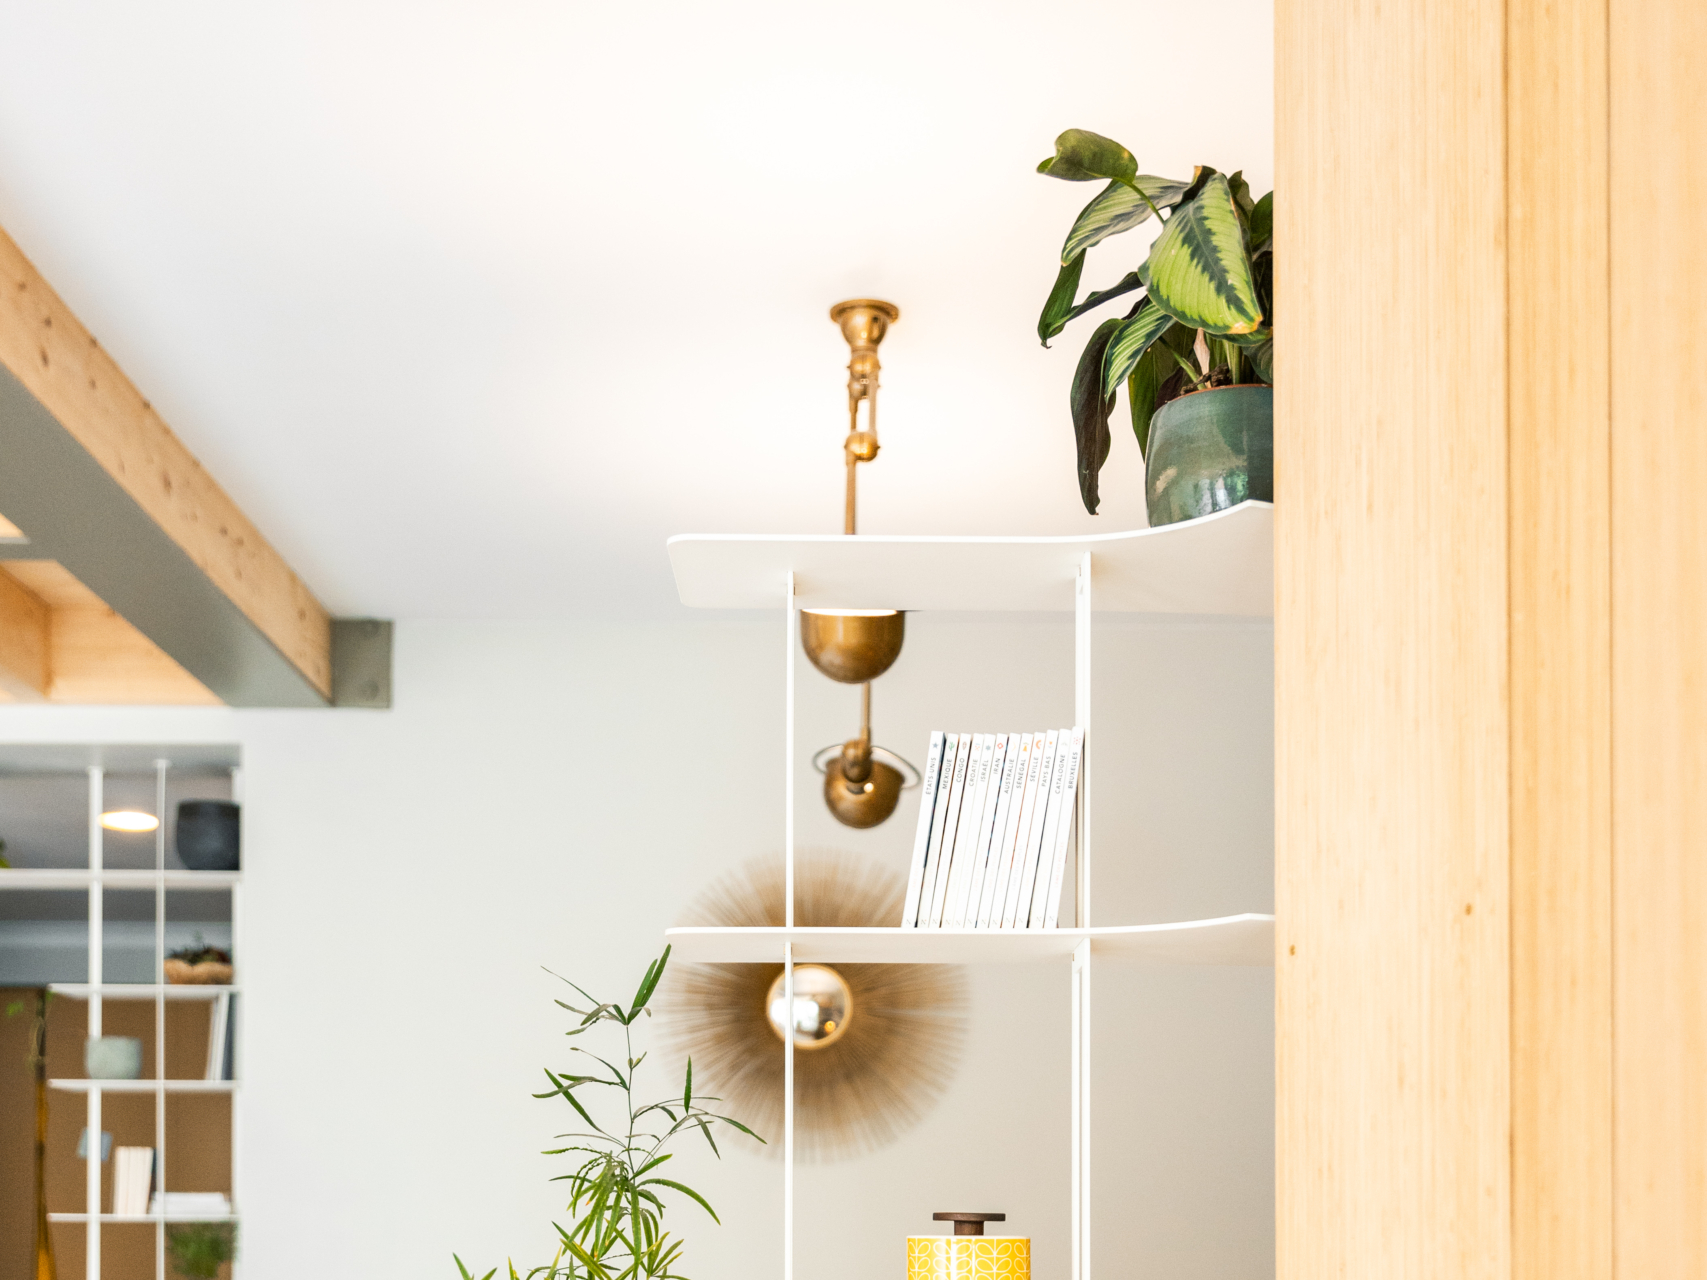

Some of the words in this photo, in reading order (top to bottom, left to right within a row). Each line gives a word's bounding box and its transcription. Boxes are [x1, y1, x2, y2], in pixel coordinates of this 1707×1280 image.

[942, 758, 952, 790] MEXIQUE
[956, 758, 965, 782] CONGO
[969, 758, 978, 786] CROATIE
[980, 760, 988, 782] ISRAËL
[1004, 758, 1014, 794] AUSTRALIE
[1030, 757, 1039, 782] SÉVILLE
[1054, 754, 1066, 794] CATALOGNE
[1068, 752, 1078, 789] BRUXELLES
